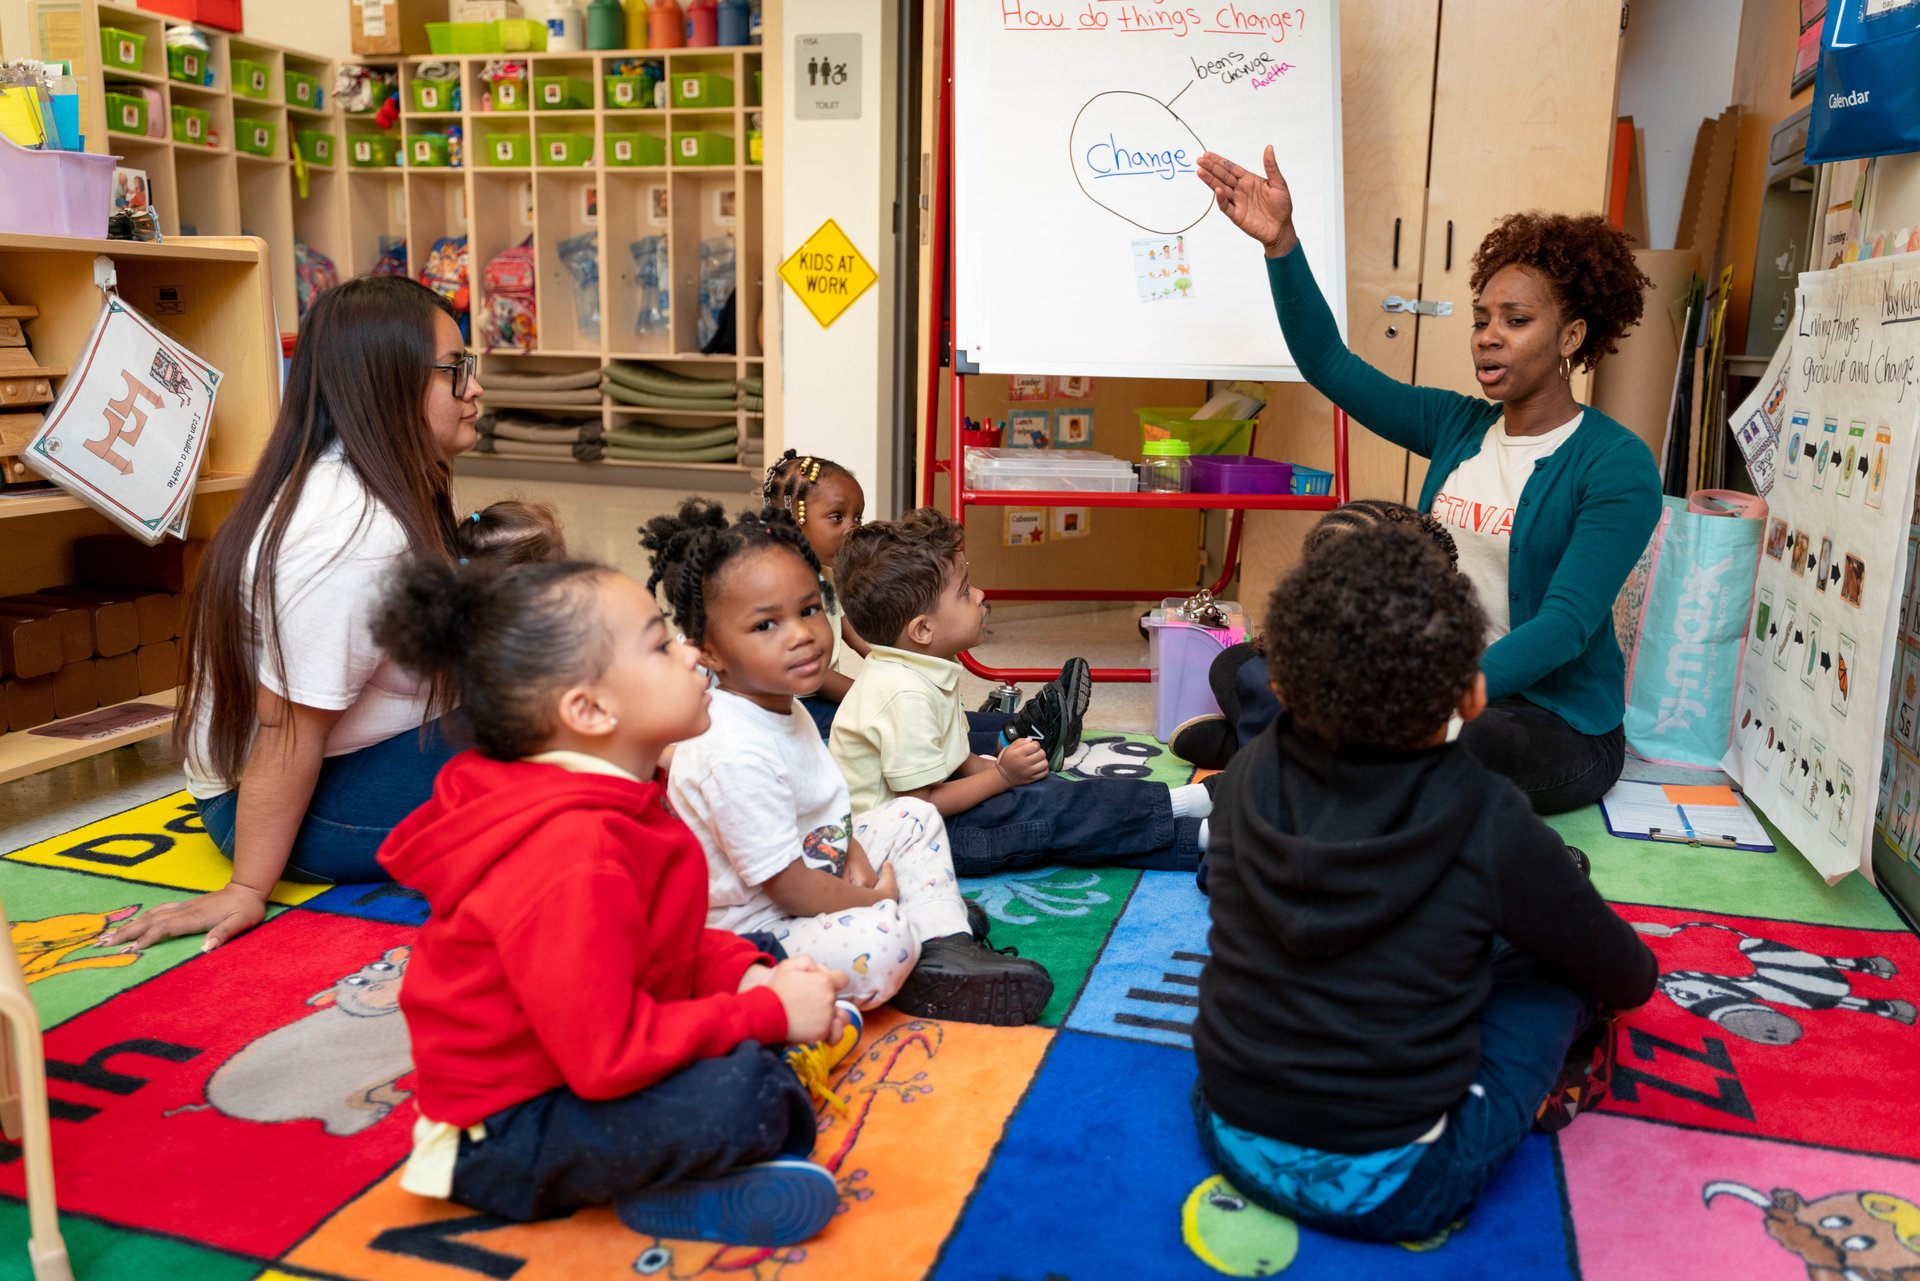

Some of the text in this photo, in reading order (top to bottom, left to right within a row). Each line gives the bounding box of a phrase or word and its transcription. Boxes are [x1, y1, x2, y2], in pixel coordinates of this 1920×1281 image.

[1001, 0, 1064, 28] How
[1079, 2, 1109, 28] do
[1117, 5, 1201, 37] things
[1190, 51, 1245, 80] beans
[815, 101, 840, 109] TOILET
[1828, 90, 1870, 109] Calendar
[1086, 133, 1192, 180] Change
[799, 252, 855, 273] KIDS AT
[806, 275, 848, 295] WORK
[1850, 339, 1874, 384] and
[1016, 377, 1041, 386] Leader
[166, 412, 201, 488] I can build a castle
[1011, 515, 1038, 523] Caboose
